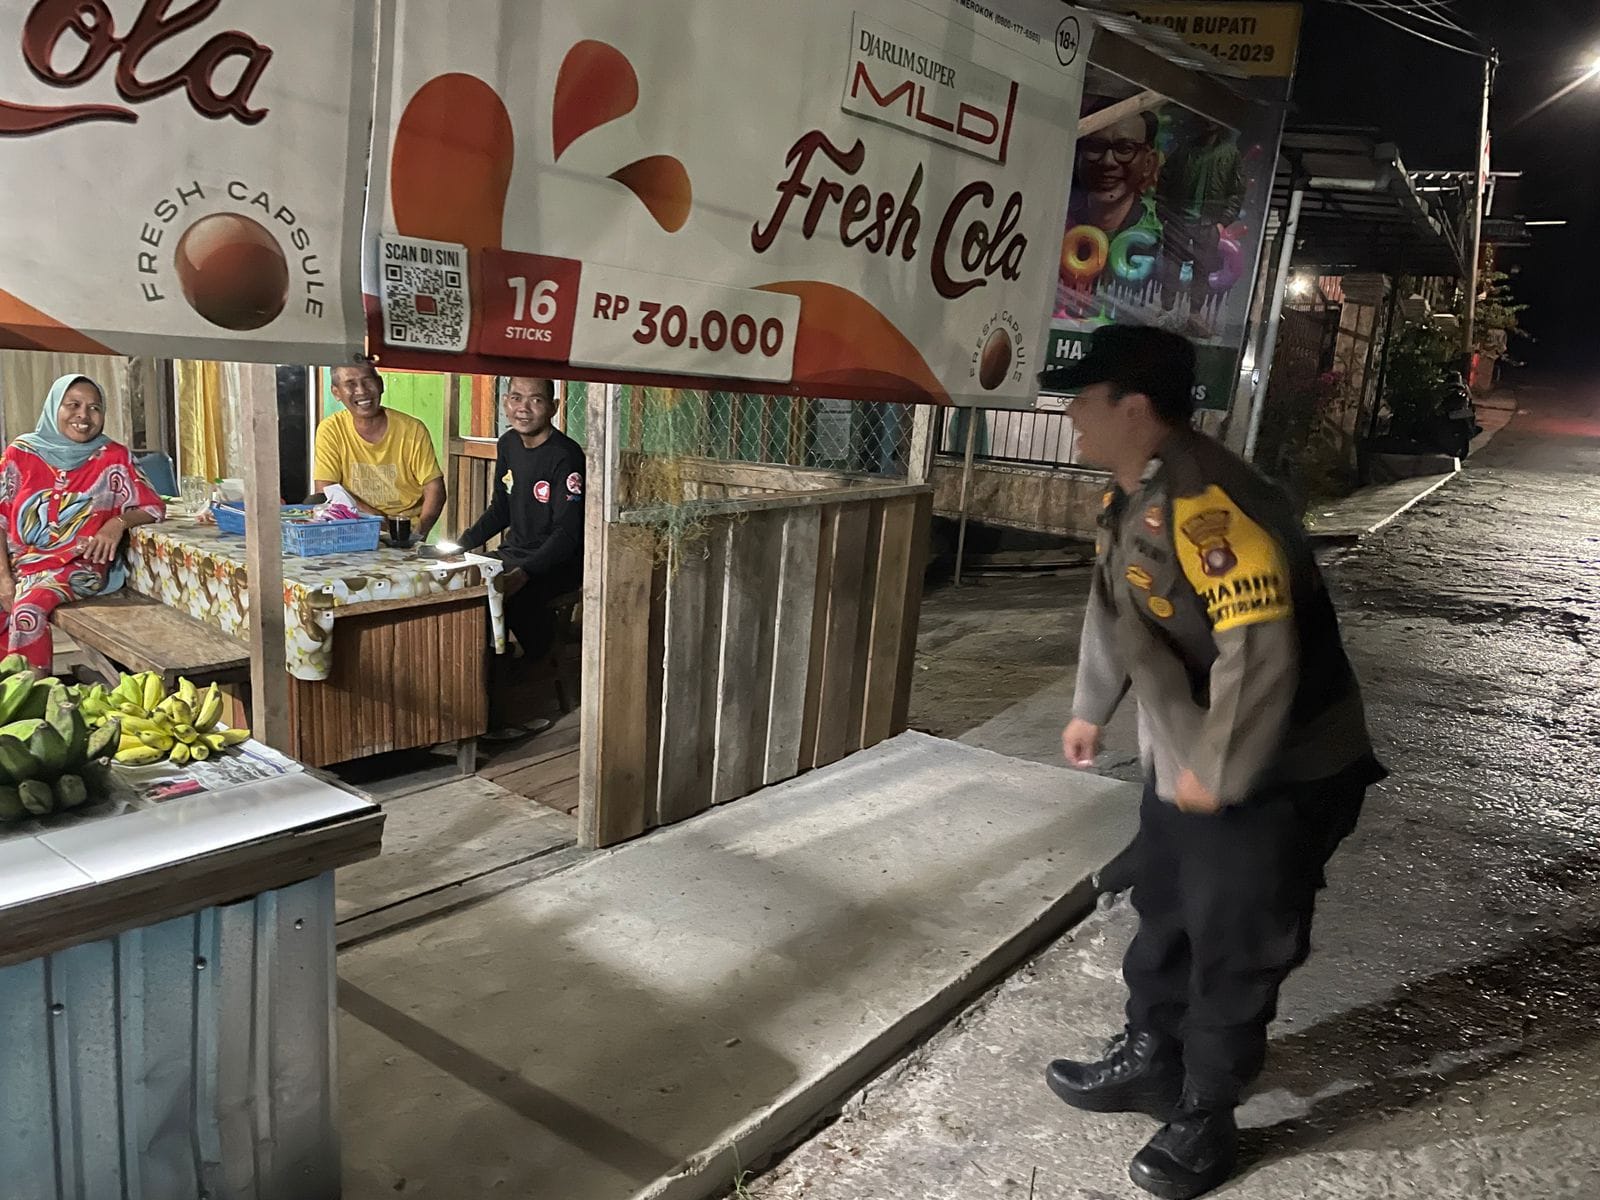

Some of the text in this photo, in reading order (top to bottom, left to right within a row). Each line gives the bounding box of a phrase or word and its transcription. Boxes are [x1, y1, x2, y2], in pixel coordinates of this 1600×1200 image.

[1059, 30, 1077, 50] 18+
[1192, 16, 1257, 35] BUPATI
[0, 0, 274, 138] ola
[859, 29, 956, 89] DJARUM SUPER
[751, 129, 1029, 300] Fresh Cola
[137, 180, 325, 319] FRESH CAPSULE
[385, 242, 460, 267] SCAN DI SINI
[507, 275, 560, 325] 16
[593, 291, 784, 358] RP 30.000
[505, 325, 553, 343] STICKS
[1001, 310, 1027, 383] CAPSULE
